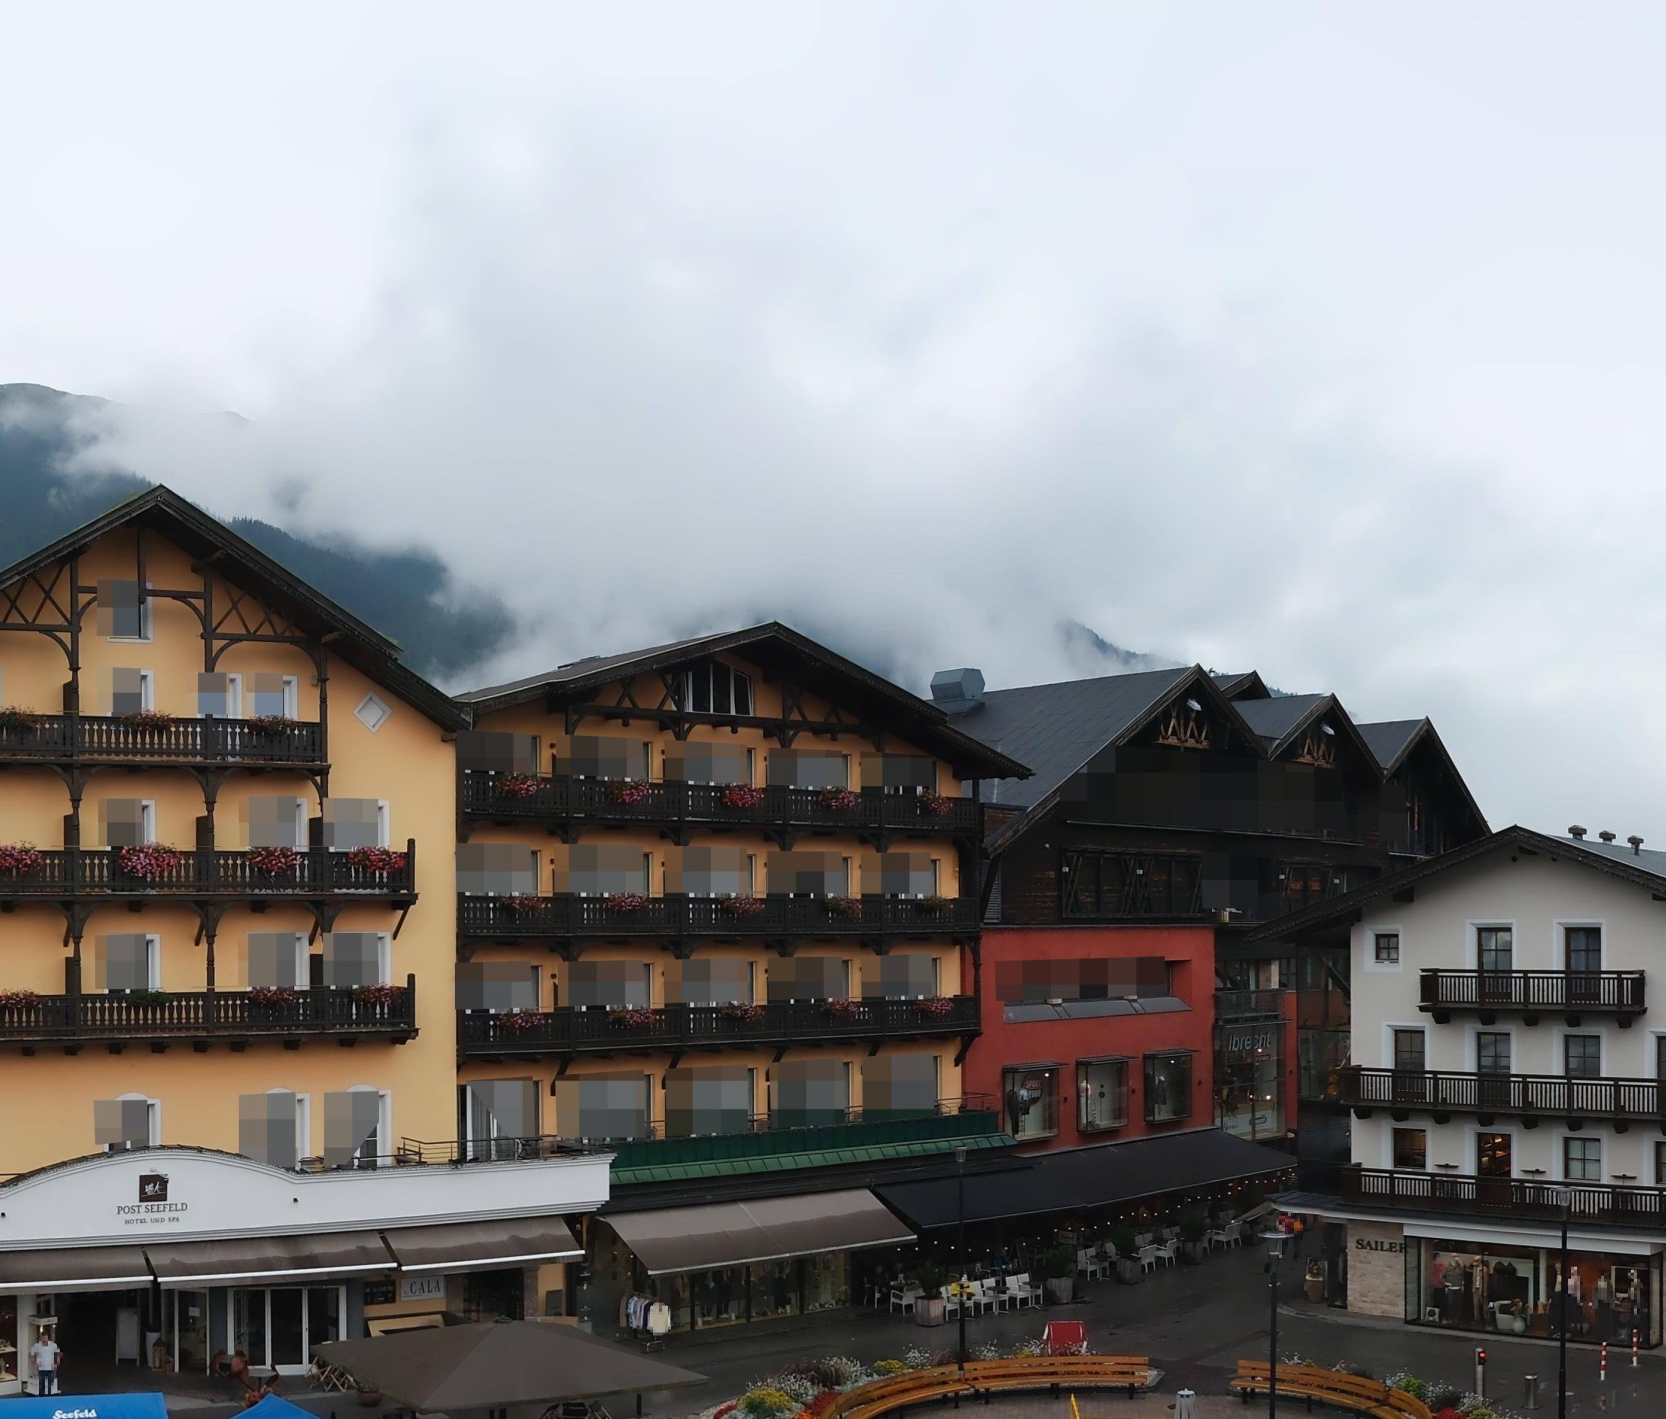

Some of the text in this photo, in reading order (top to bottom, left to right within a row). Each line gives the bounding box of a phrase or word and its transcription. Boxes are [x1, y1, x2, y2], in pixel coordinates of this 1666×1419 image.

[117, 1203, 188, 1215] POST SEEFELD
[52, 1408, 98, 1419] Seefeld
